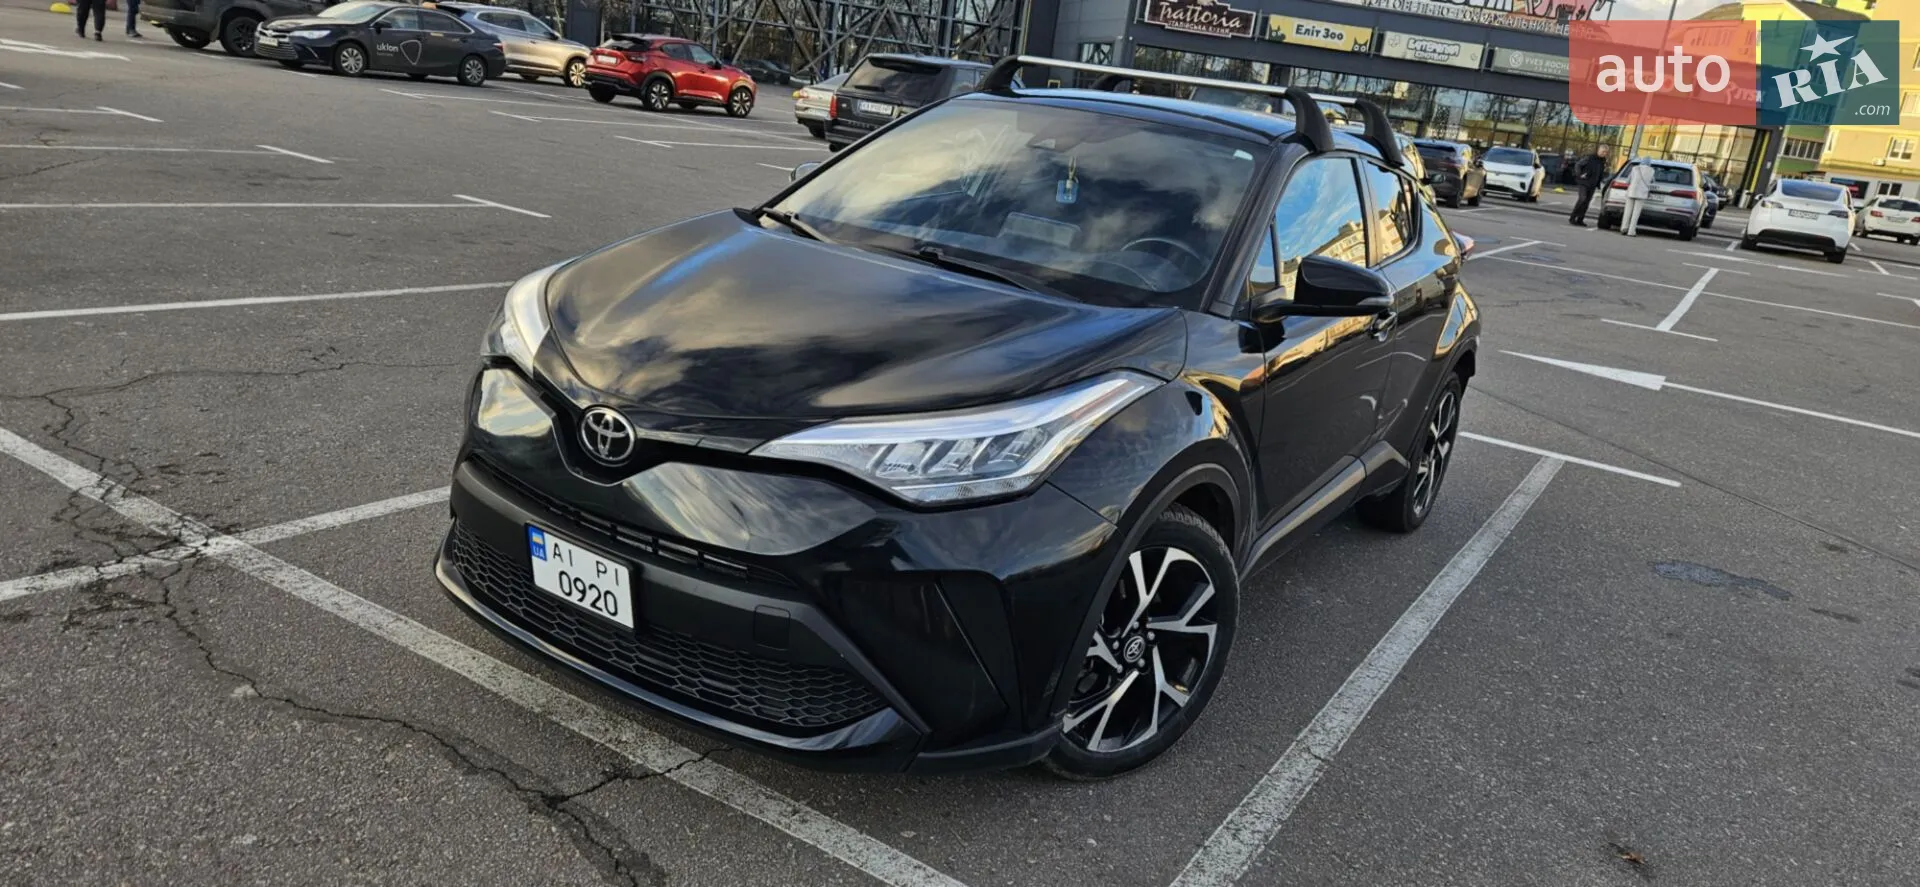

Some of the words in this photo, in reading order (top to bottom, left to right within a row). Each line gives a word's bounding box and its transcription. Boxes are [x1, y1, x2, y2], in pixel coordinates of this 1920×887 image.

[1159, 2, 1242, 28] Trattoria
[1296, 24, 1321, 37] Еліт
[1323, 28, 1344, 41] Зоо
[376, 42, 399, 52] uklon
[532, 546, 545, 559] UA
[558, 570, 618, 617] 0920
